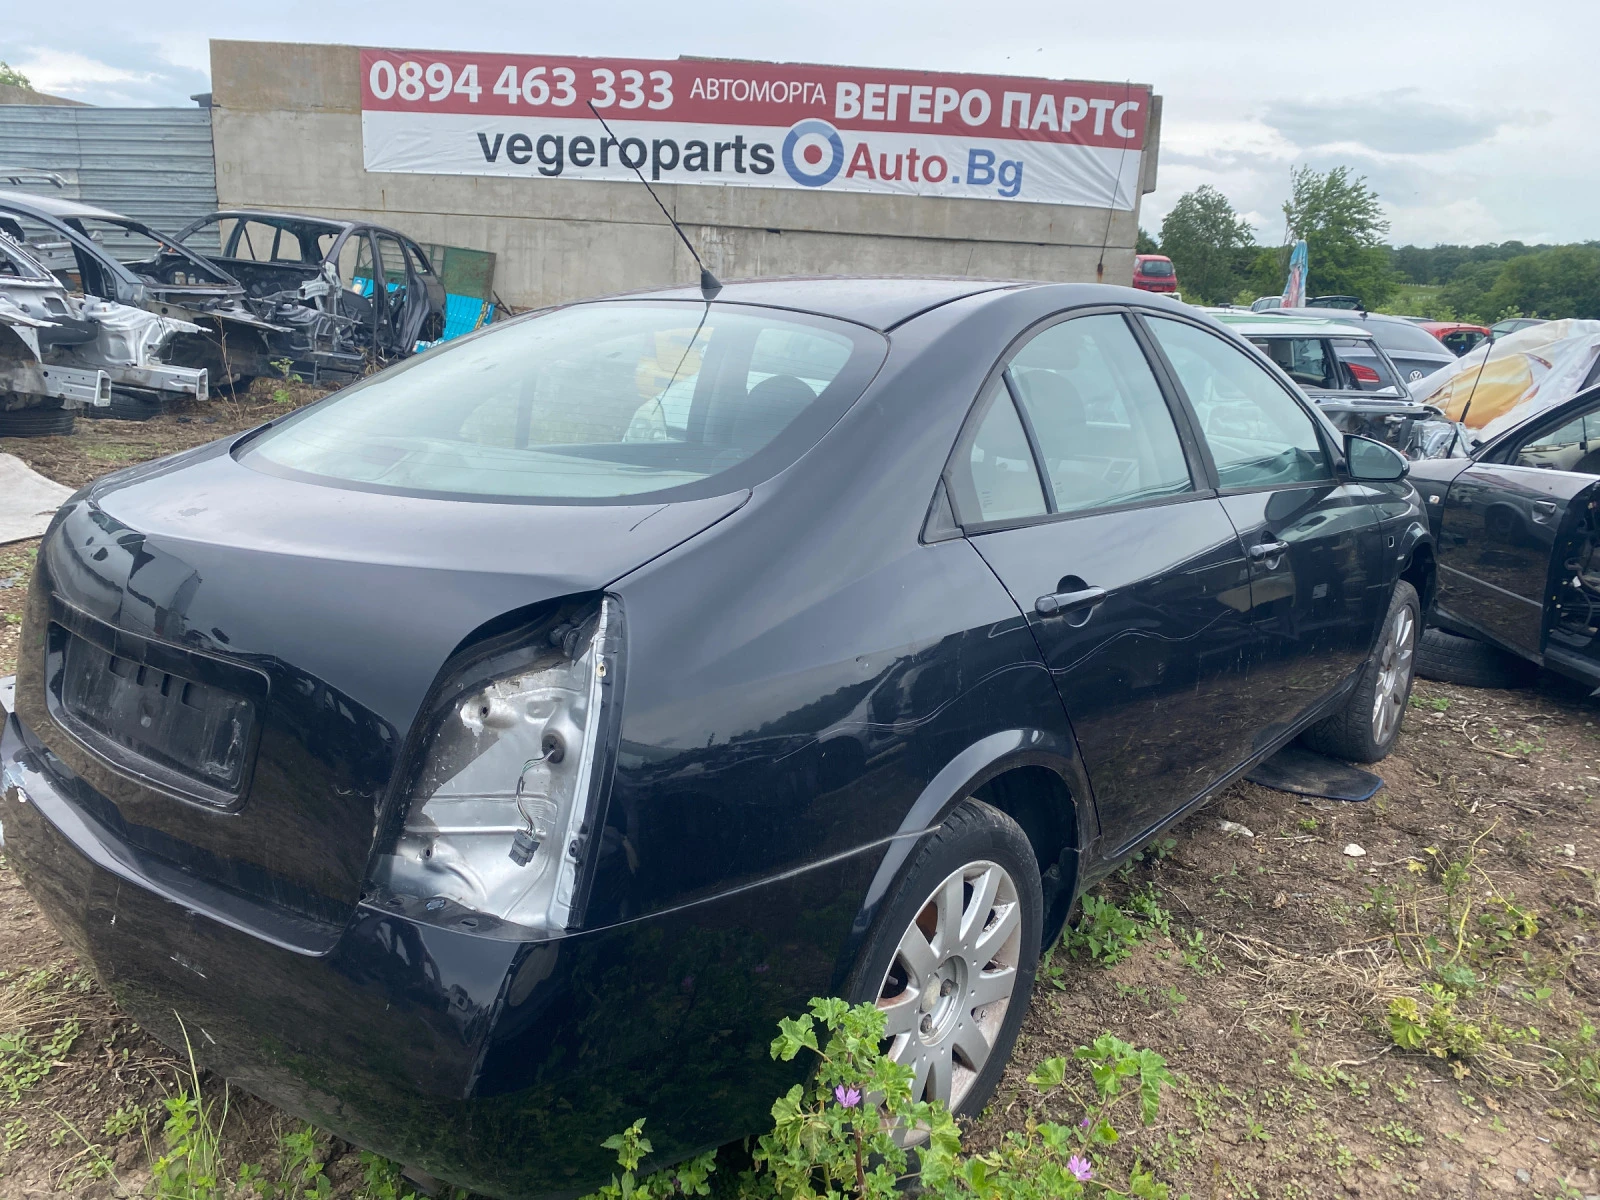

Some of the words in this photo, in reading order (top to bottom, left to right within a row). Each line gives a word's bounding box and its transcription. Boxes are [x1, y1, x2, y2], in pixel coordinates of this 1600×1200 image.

[369, 59, 482, 103] 0894
[493, 65, 577, 107] 463
[591, 68, 674, 110] 333
[689, 77, 827, 105] АВТОМОРГА
[834, 81, 992, 127] ВЕГЕРО
[1001, 91, 1140, 139] ПАРТС
[477, 131, 775, 181] vegeroparts
[845, 141, 1024, 198] Auto.Bg
